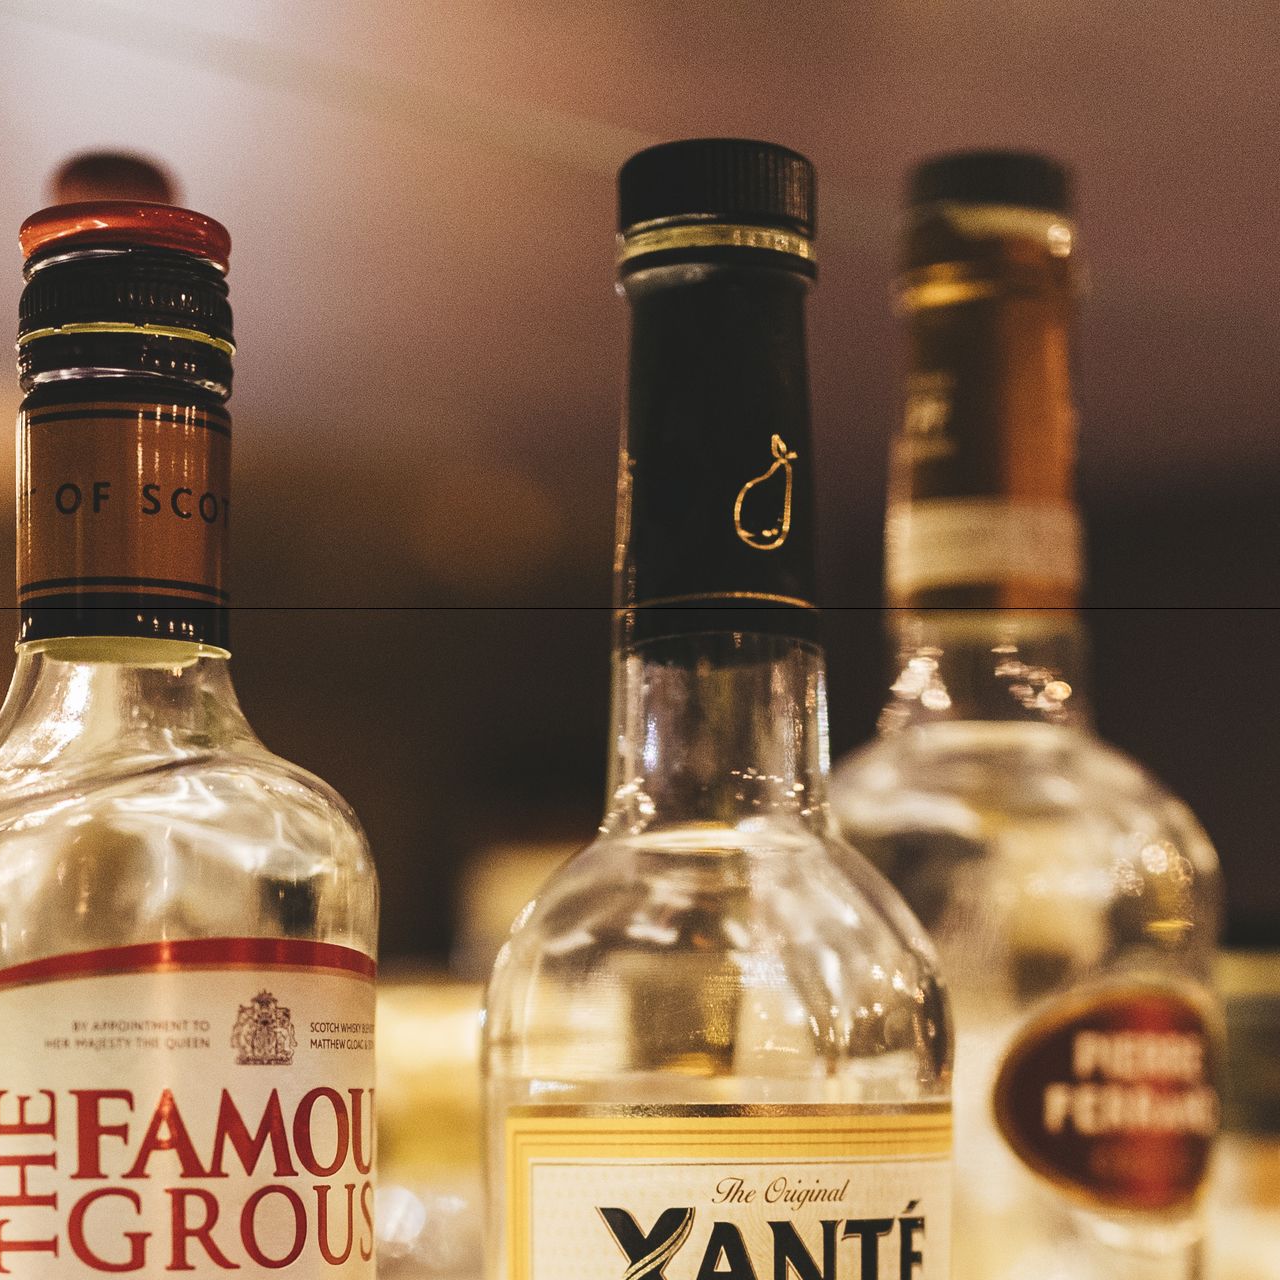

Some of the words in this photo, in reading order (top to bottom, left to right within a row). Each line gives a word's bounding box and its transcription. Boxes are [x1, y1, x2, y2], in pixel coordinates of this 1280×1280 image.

[55, 481, 112, 515] OF
[191, 1018, 211, 1032] TO
[310, 1021, 340, 1033] SCOTCH
[166, 1037, 211, 1051] QUEEN
[310, 1038, 347, 1050] MATTHEW
[712, 1177, 756, 1204] The
[763, 1175, 851, 1212] Original
